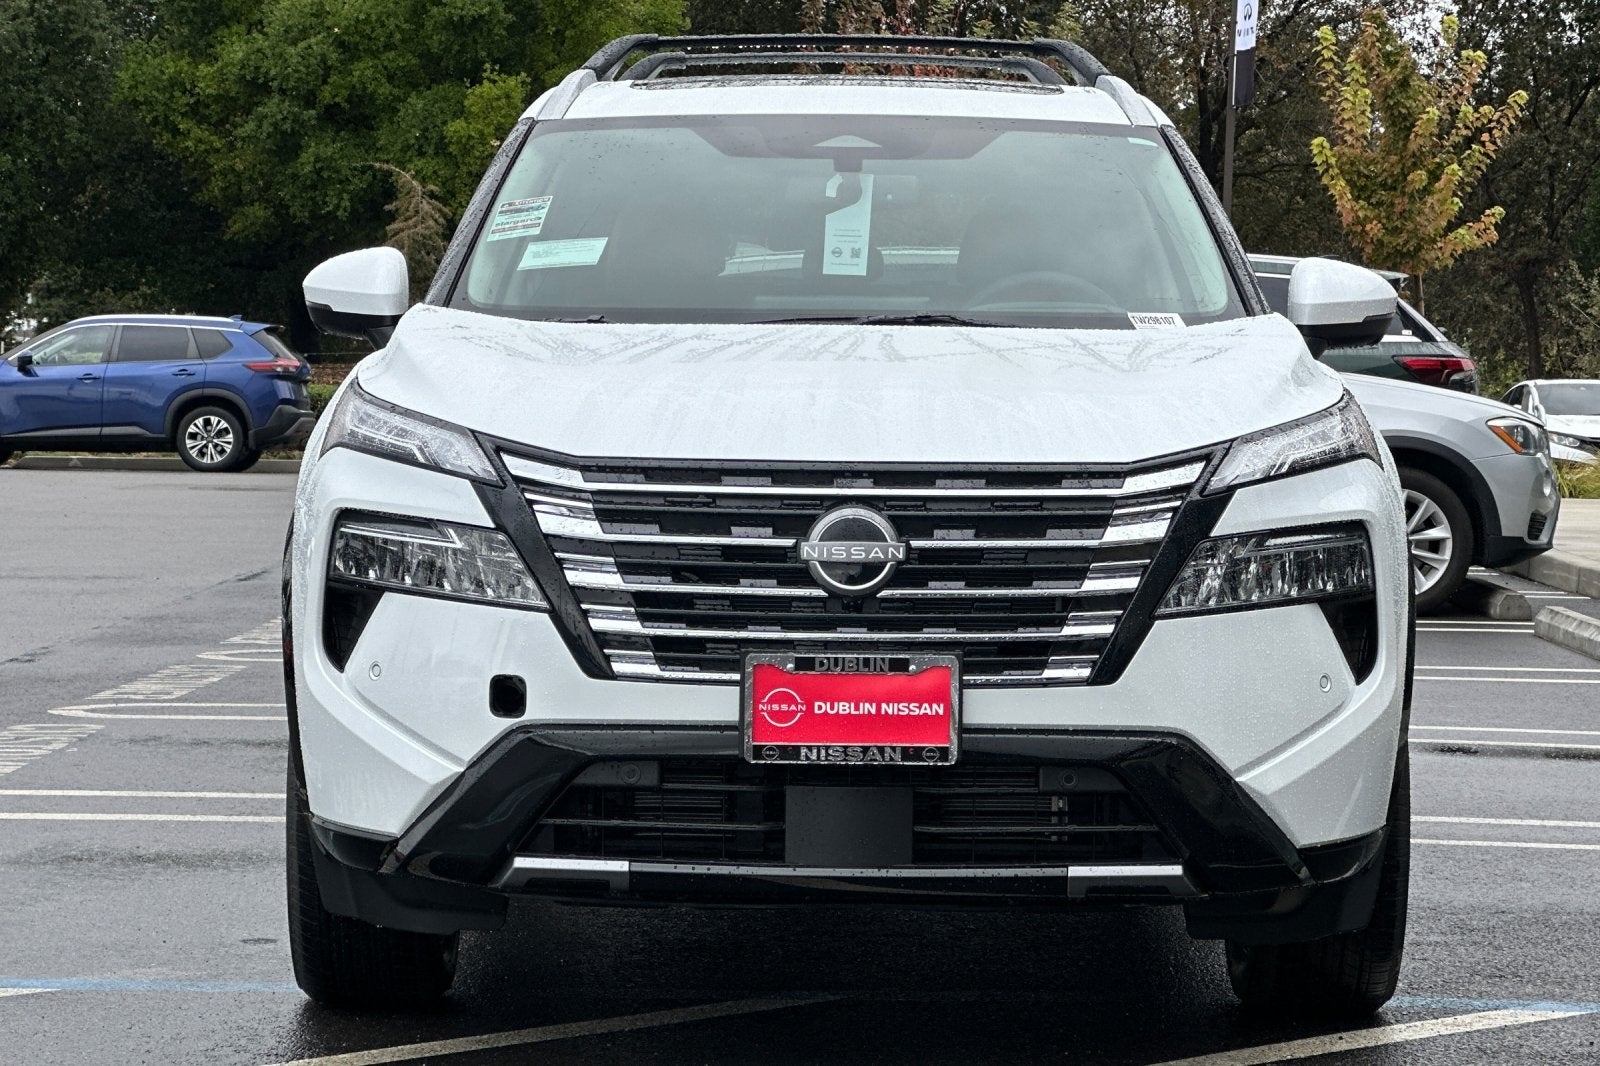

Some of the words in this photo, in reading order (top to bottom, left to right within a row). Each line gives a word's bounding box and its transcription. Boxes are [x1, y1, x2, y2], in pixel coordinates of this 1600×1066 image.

[803, 546, 904, 559] NISSAN
[814, 656, 890, 673] DUBLIN
[759, 703, 806, 711] NISSAN
[814, 701, 877, 715] DUBLIN
[881, 702, 944, 716] NISSAN
[800, 746, 902, 761] NISSAN
